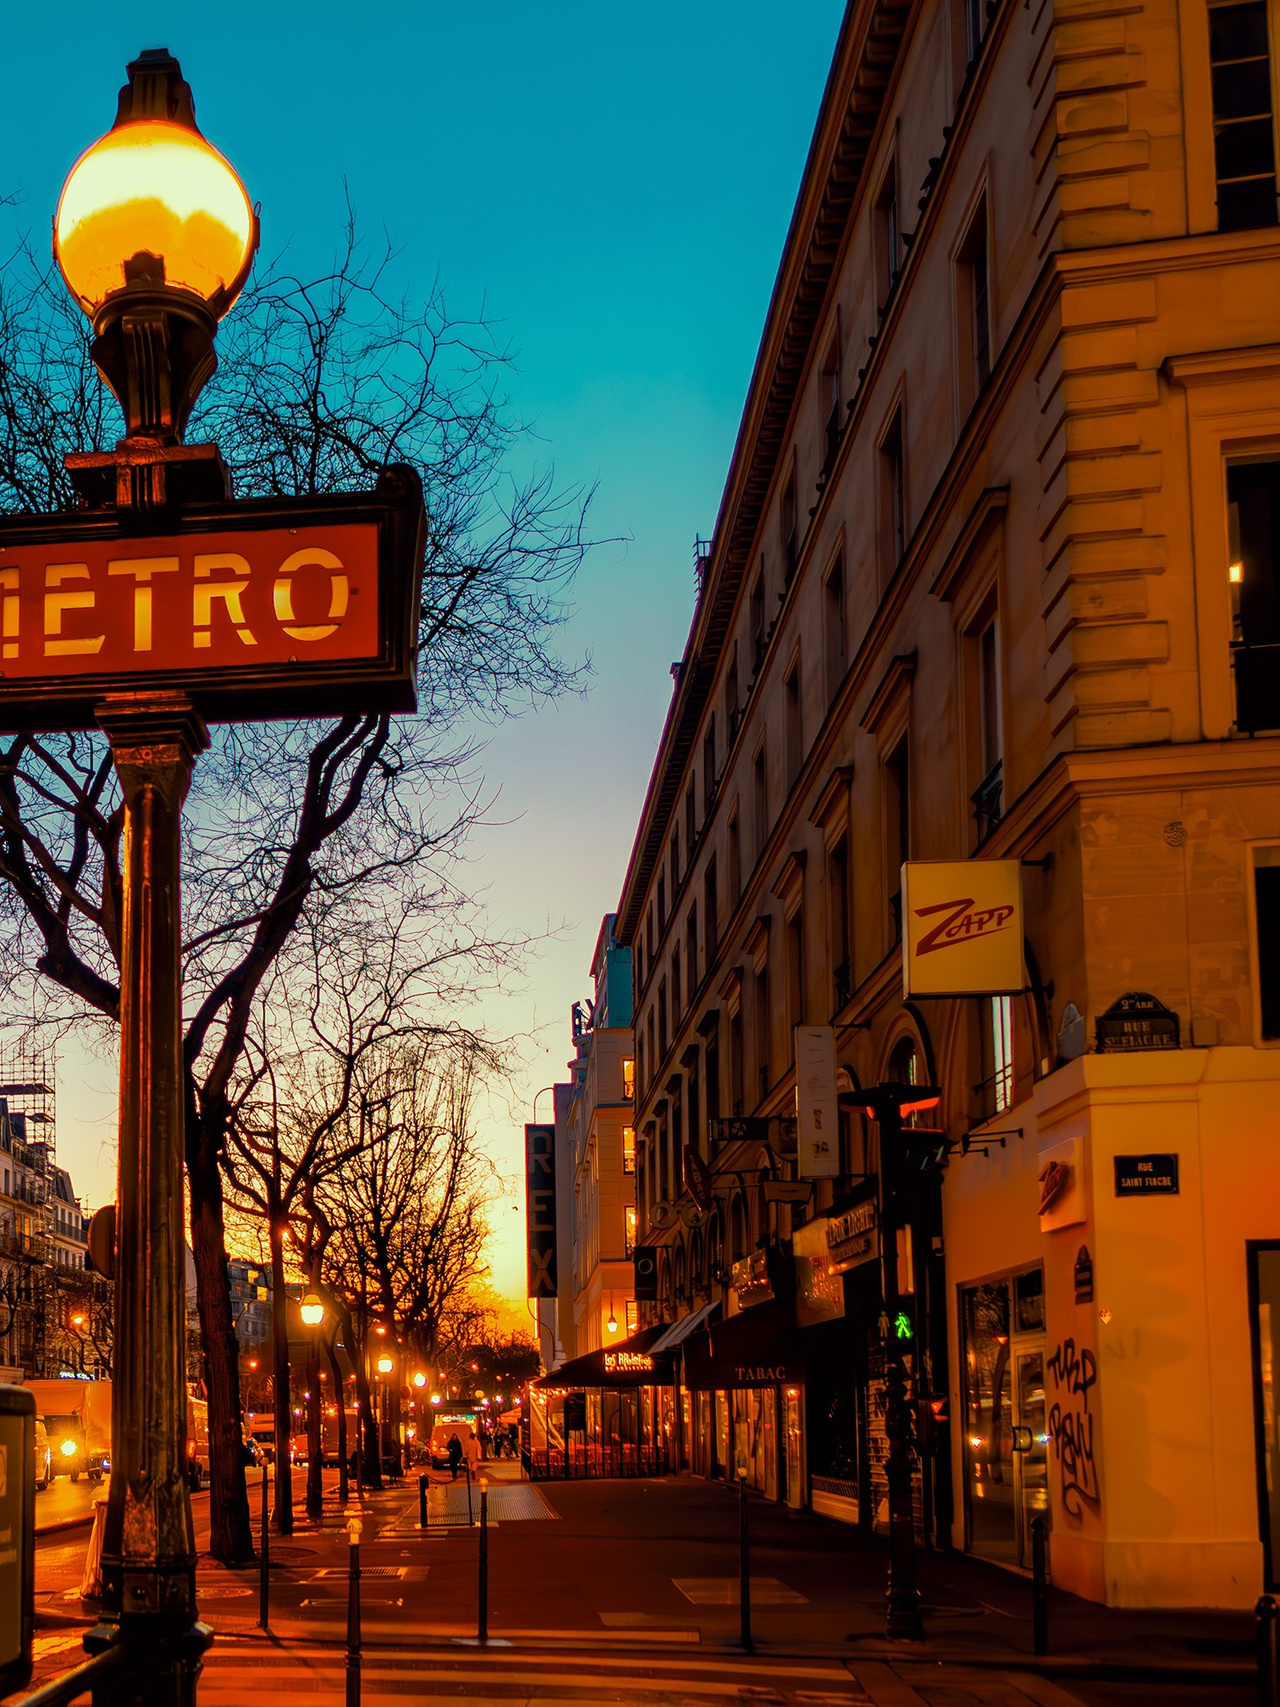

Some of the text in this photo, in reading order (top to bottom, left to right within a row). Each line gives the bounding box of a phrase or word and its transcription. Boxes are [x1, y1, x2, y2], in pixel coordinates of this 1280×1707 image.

[1137, 1162, 1154, 1172] RUE
[1121, 1176, 1172, 1187] SAINT FIACRE
[528, 1131, 555, 1291] REX
[734, 1366, 786, 1381] TABAC
